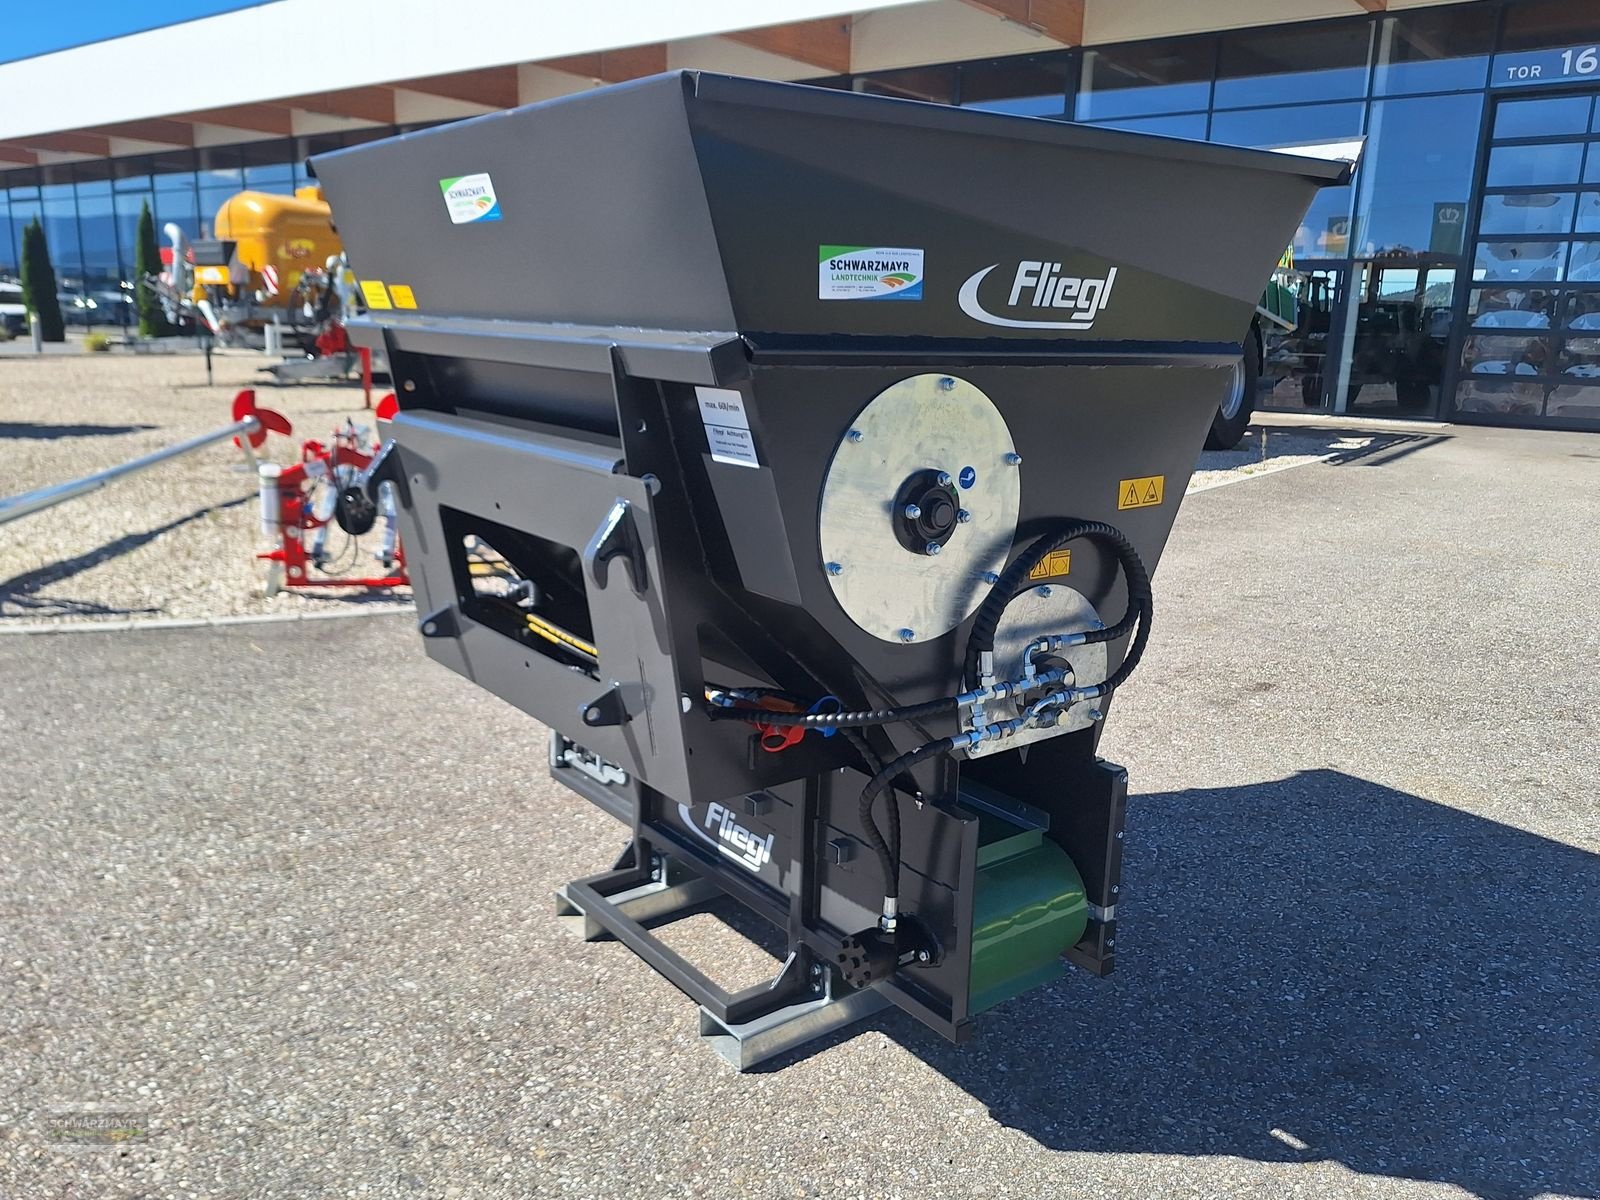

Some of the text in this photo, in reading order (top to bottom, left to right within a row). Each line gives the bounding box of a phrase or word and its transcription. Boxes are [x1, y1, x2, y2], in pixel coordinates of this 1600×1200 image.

[1507, 47, 1598, 80] TOR 16
[829, 259, 910, 272] SCHWARZMAYR
[831, 273, 879, 282] LANDTECHNIK
[1008, 260, 1118, 321] Fliegl
[704, 801, 775, 867] Fliegl
